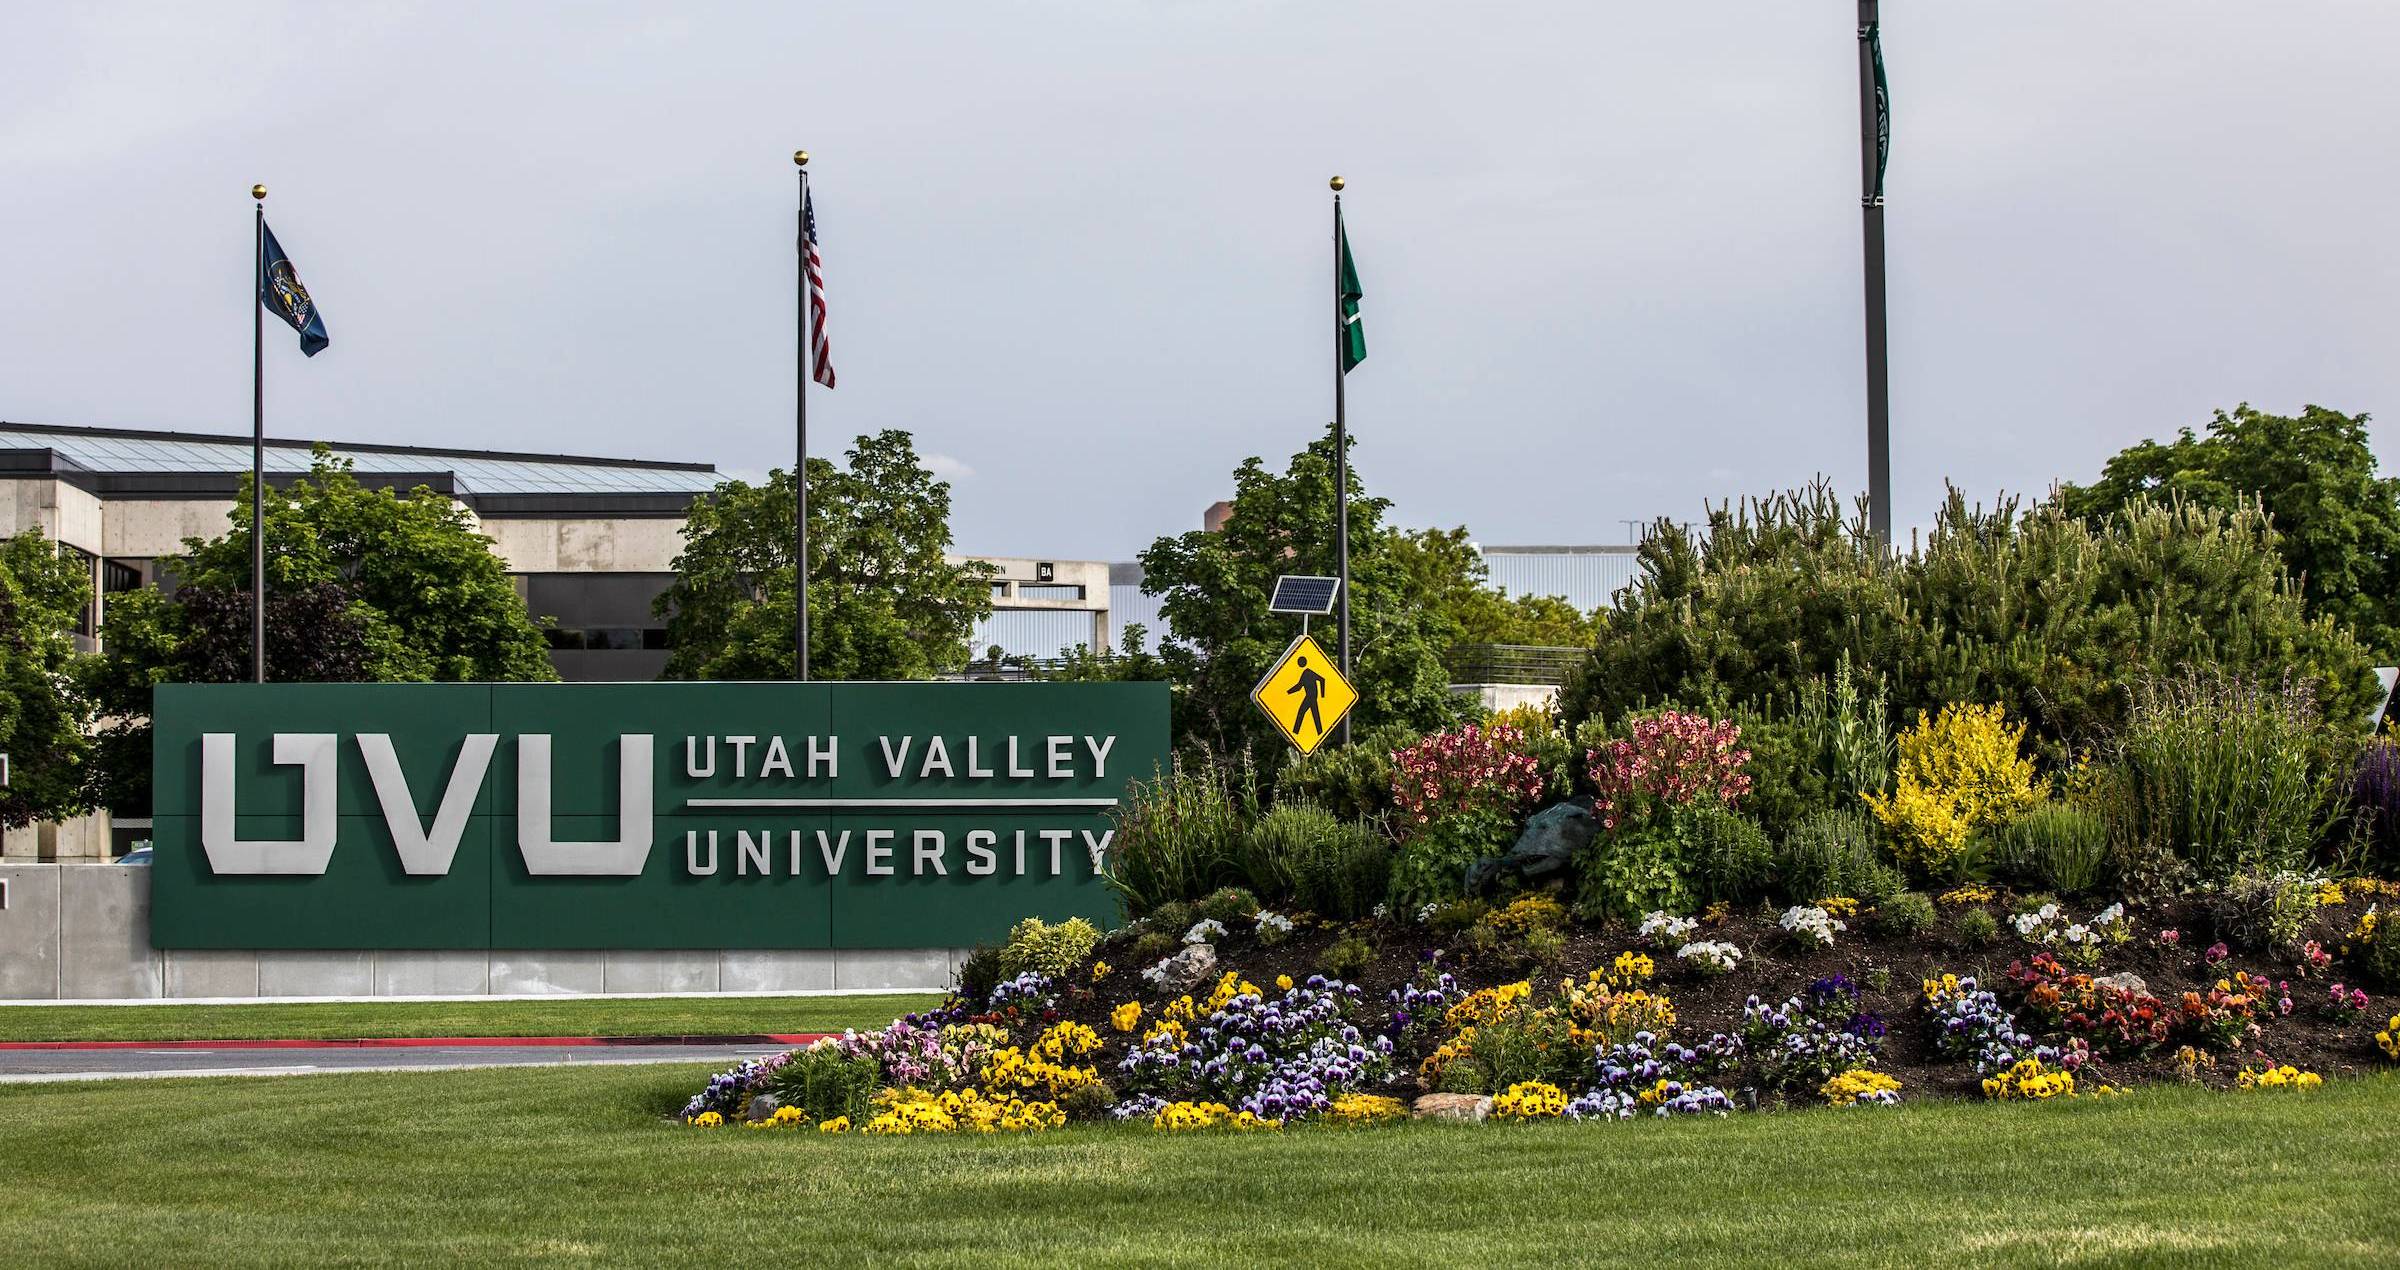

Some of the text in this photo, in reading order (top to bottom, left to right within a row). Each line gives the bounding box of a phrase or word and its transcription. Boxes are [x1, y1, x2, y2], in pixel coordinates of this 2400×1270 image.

[1040, 566, 1053, 577] BA
[686, 735, 1117, 778] UTAH VALLEY
[201, 732, 655, 876] UVU
[686, 829, 1116, 876] UNIVERSITY
